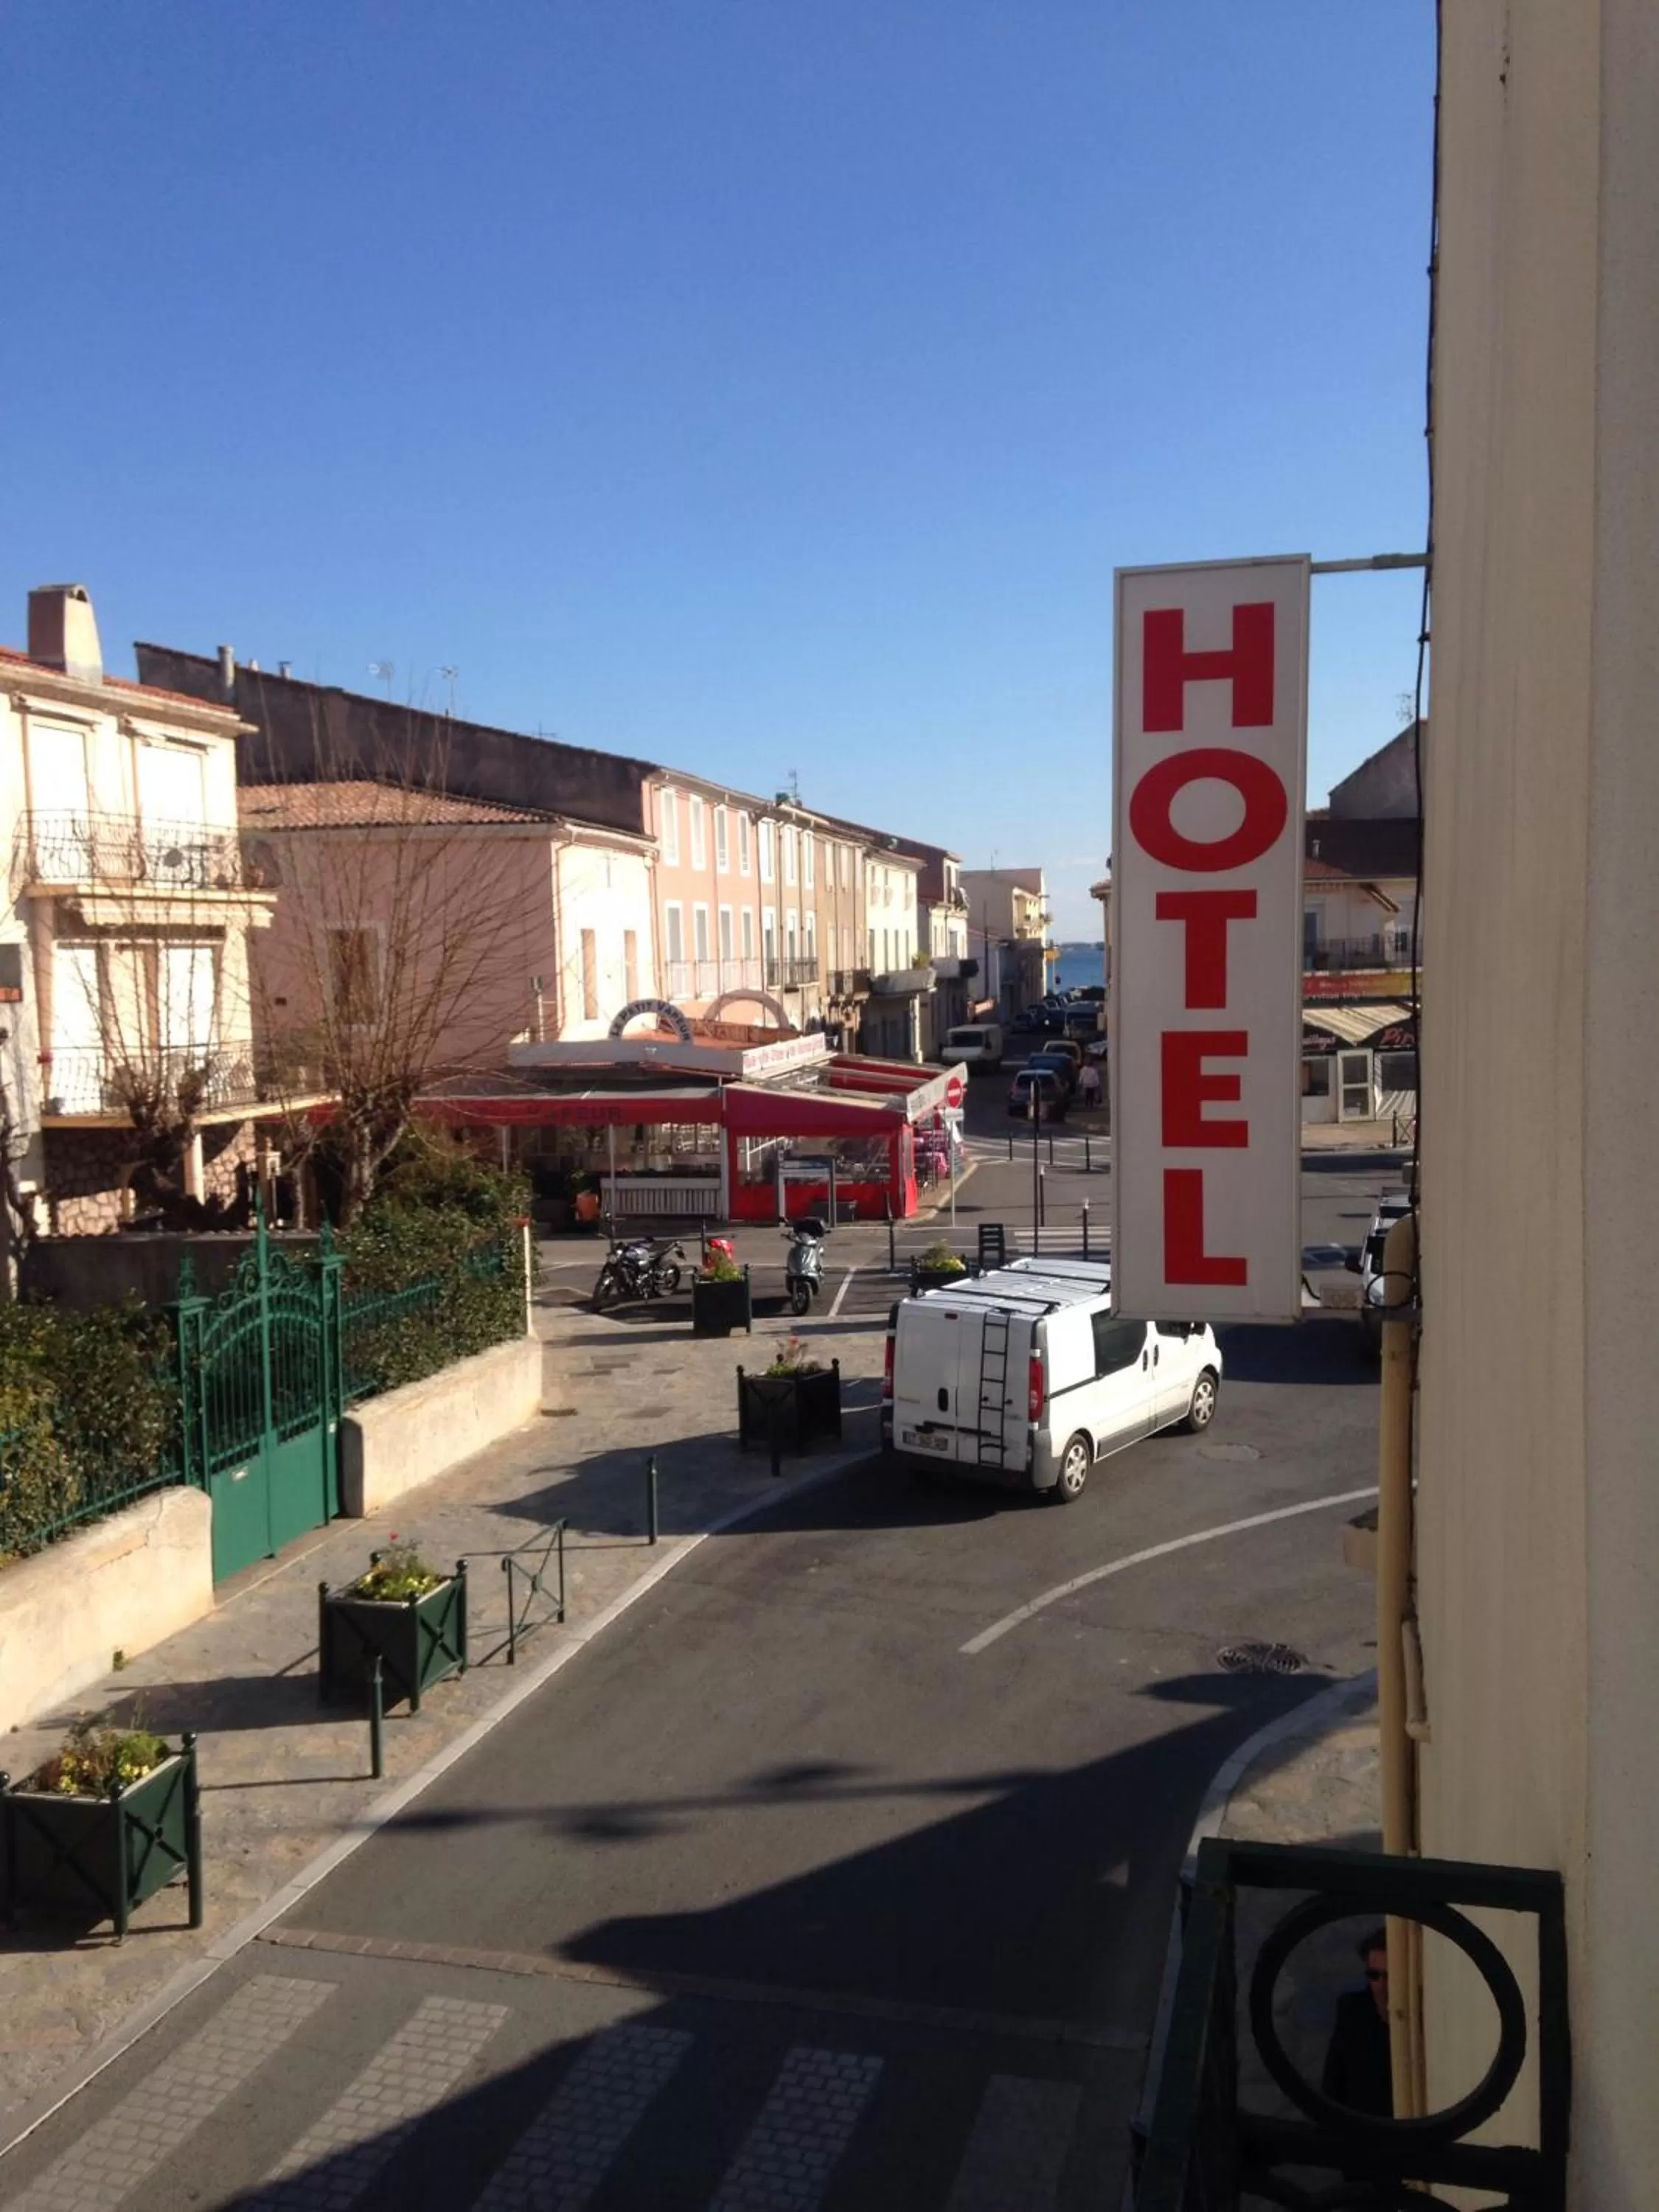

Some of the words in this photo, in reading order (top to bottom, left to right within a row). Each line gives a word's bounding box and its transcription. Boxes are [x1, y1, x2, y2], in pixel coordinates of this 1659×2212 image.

[618, 1001, 654, 1020] PETIT
[657, 1001, 690, 1040] VAPEUR
[1130, 602, 1288, 1285] HOTEL
